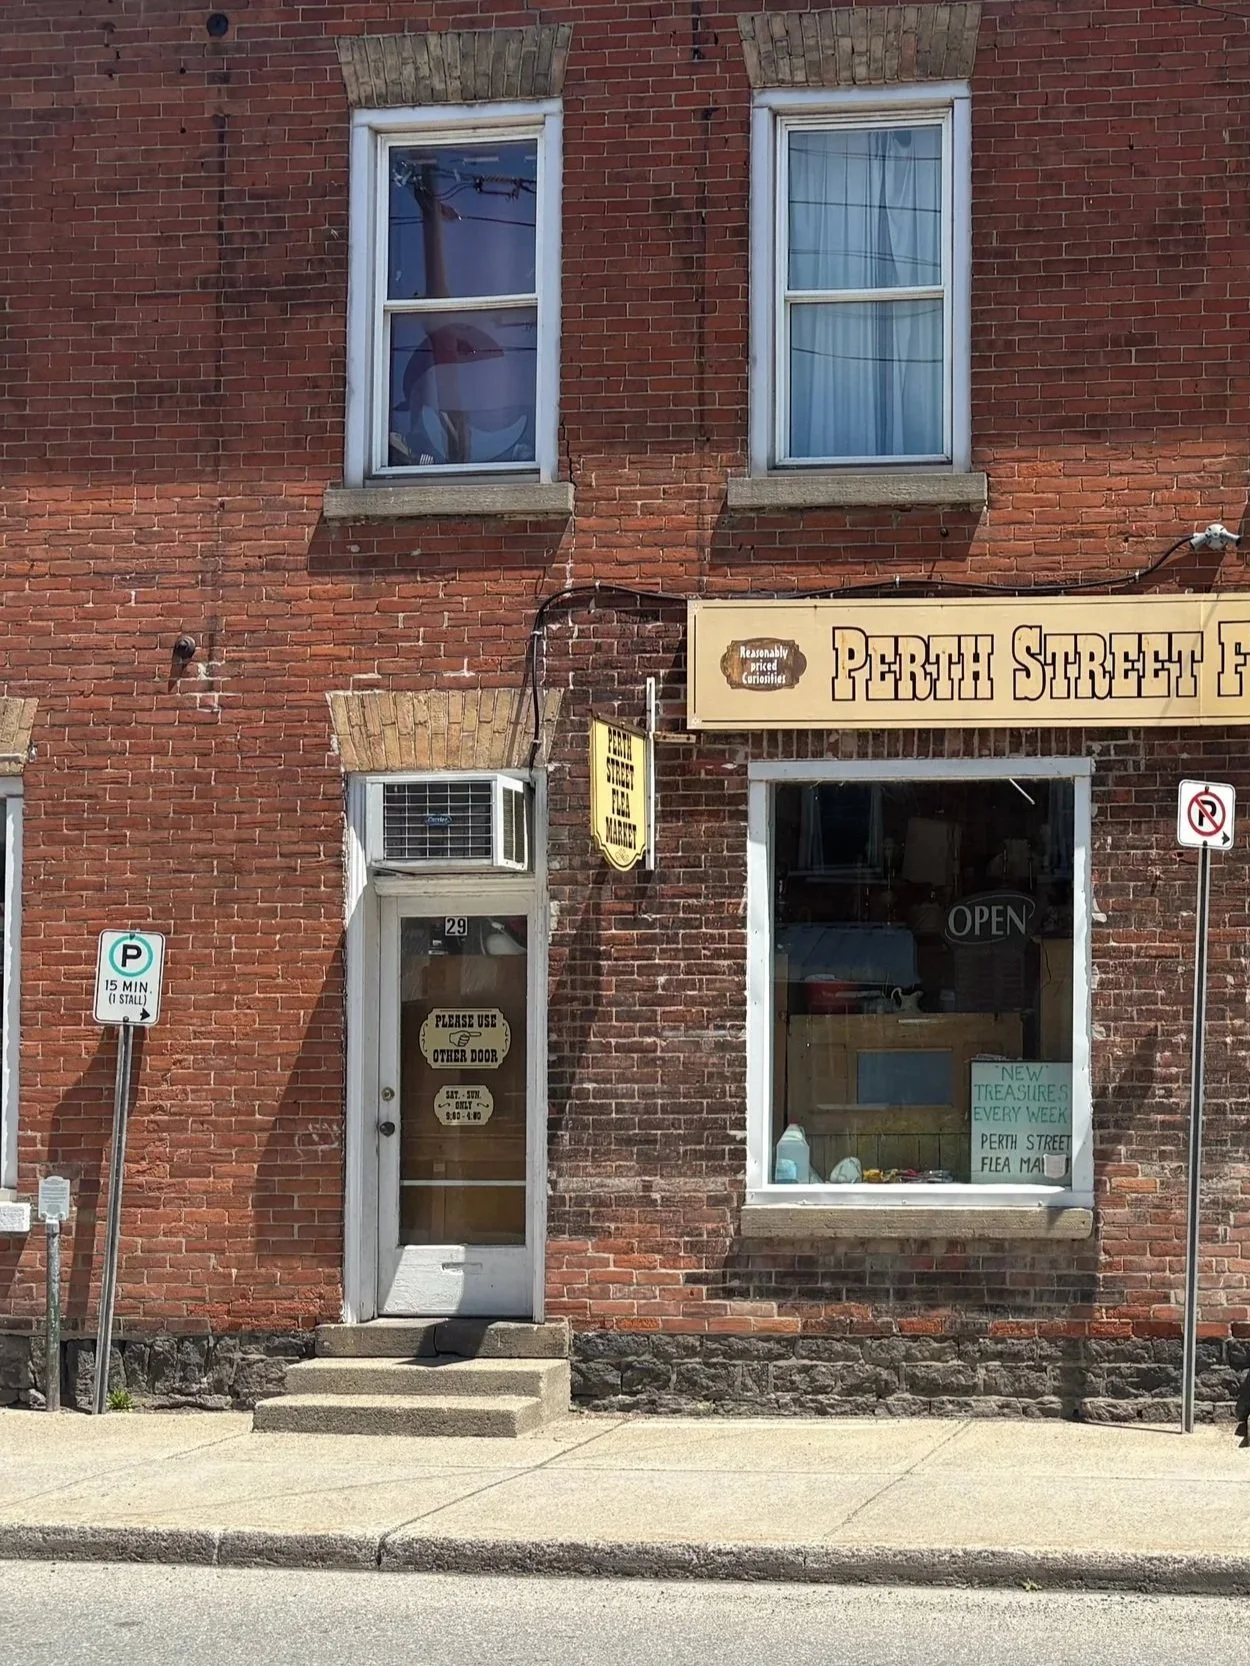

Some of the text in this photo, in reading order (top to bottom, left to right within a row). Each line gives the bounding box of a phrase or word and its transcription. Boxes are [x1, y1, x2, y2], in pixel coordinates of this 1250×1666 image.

[740, 645, 788, 660] Reasonably
[750, 659, 777, 672] priced
[832, 626, 994, 701] PERTH
[1012, 625, 1203, 700] STREET
[742, 672, 786, 684] Curiosities
[607, 726, 632, 761] PERTH
[606, 756, 634, 791] STREET
[611, 788, 630, 818] FLEA
[605, 816, 637, 850] MARKET
[446, 918, 466, 934] 29
[948, 904, 1026, 936] OPEN
[121, 944, 142, 967] P
[105, 979, 118, 991] 15
[119, 993, 147, 1006] STALL)
[435, 1014, 497, 1028] PLEASE USE
[433, 1049, 498, 1063] OTHER DOOR
[445, 1090, 460, 1099] SAT.
[466, 1090, 482, 1099] SUN.
[973, 1083, 1069, 1102] TREASURES
[455, 1101, 472, 1110] ONLY
[973, 1106, 1068, 1123] EVERY WEEK
[980, 1132, 1072, 1151] PERTH STREET
[980, 1156, 1011, 1173] FLEA
